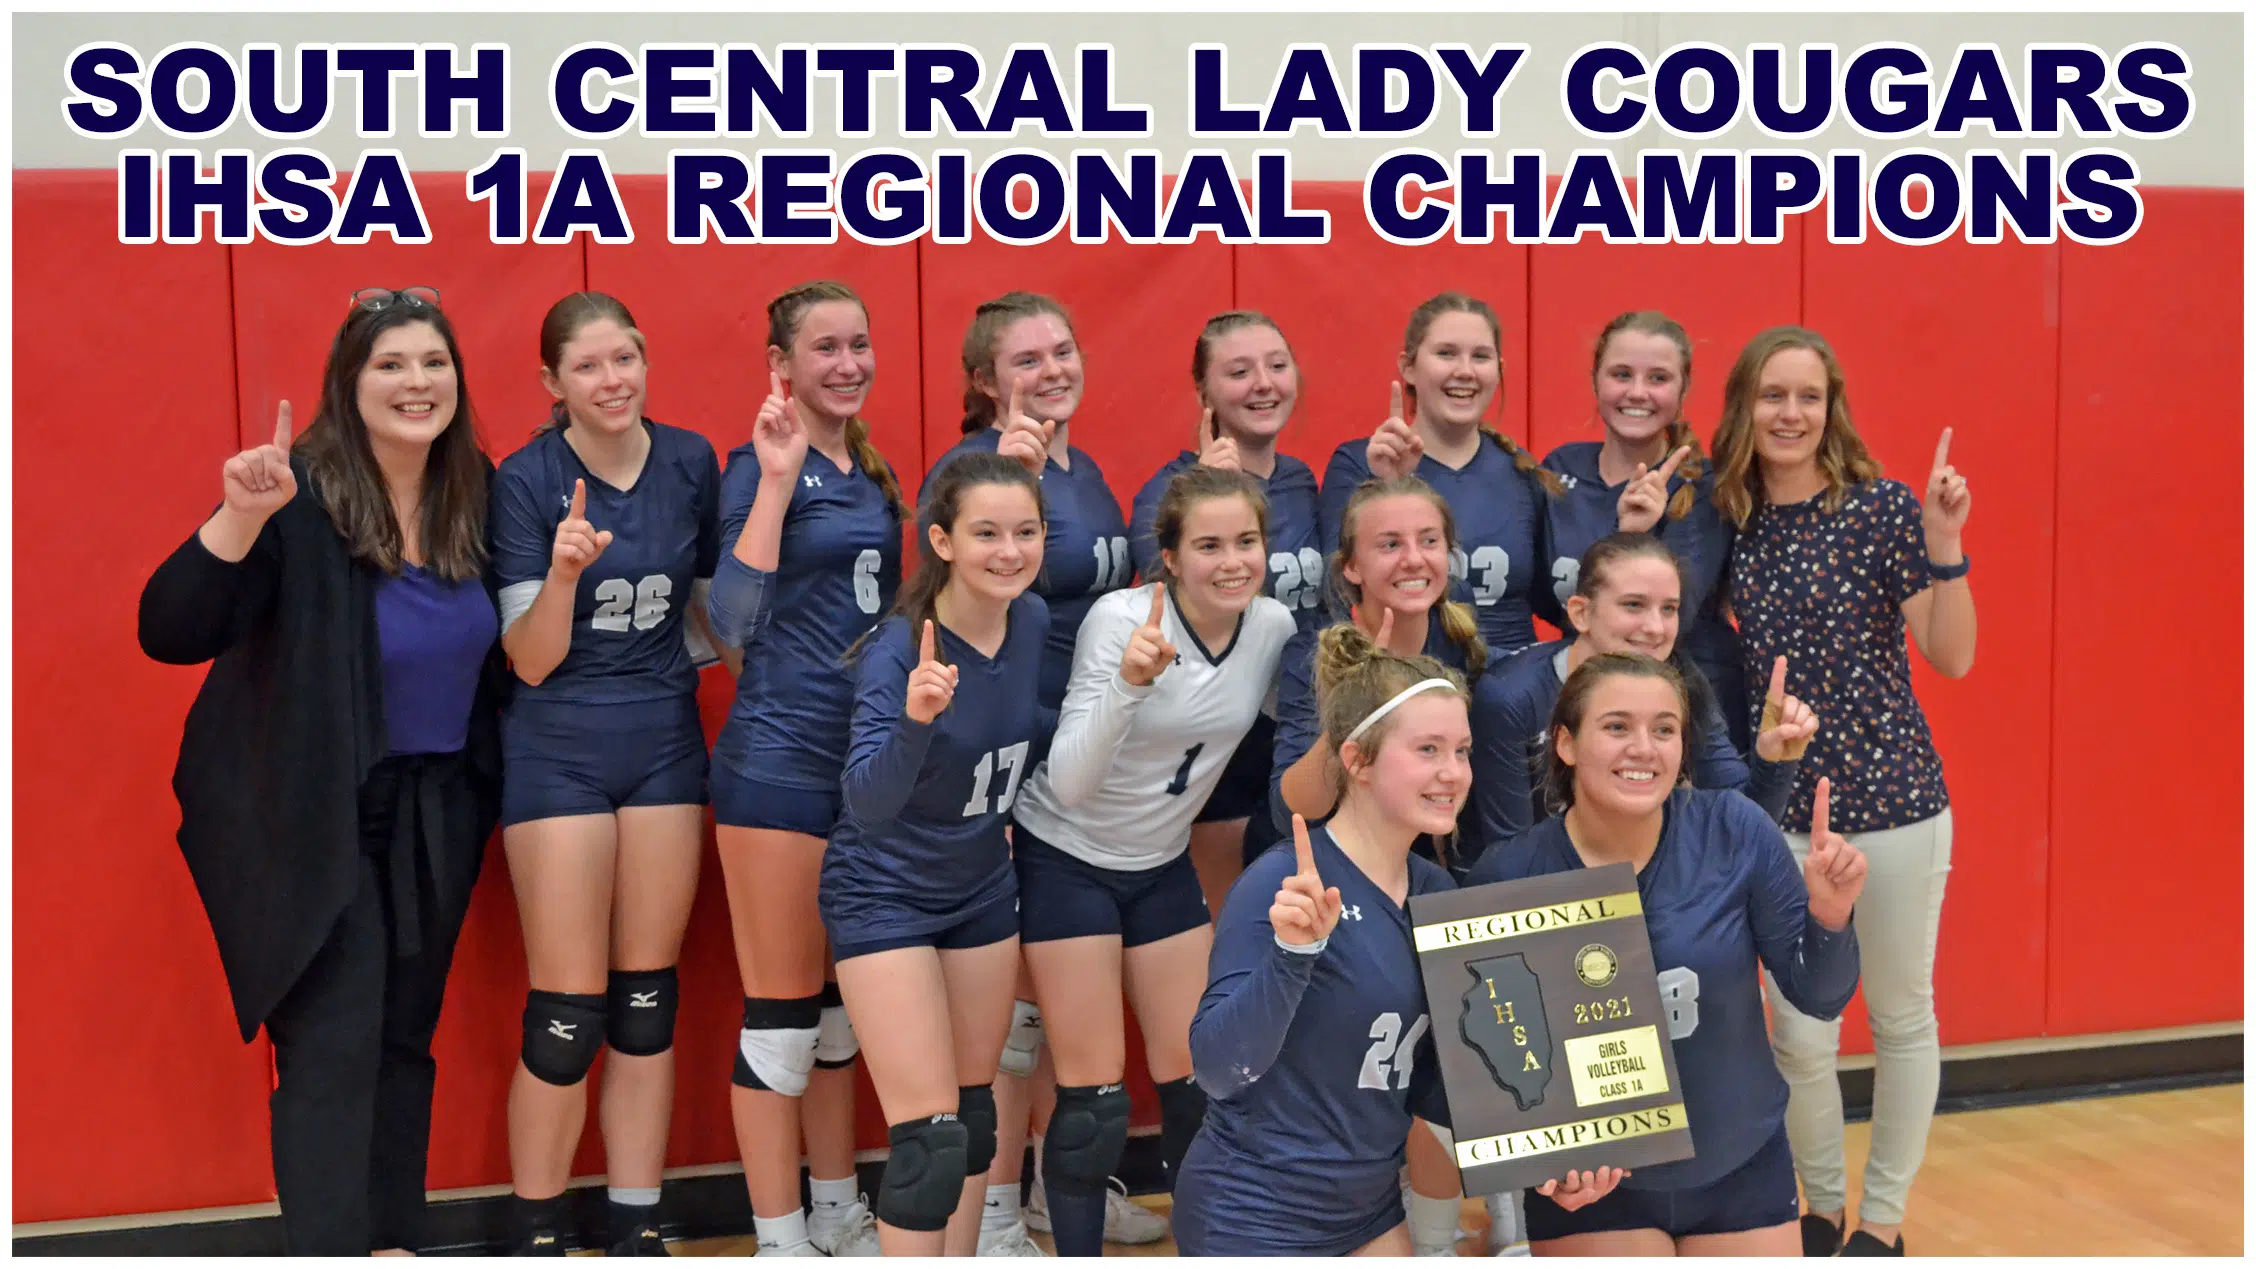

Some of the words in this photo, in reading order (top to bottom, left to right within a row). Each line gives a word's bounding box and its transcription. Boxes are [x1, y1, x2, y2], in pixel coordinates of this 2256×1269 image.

[592, 574, 672, 632] 26
[853, 549, 882, 614] 6
[1269, 547, 1323, 611] 29
[962, 741, 1029, 817] 17
[1166, 742, 1205, 796] 1
[1445, 900, 1616, 944] REGIONAL
[1574, 995, 1633, 1024] 2021
[1587, 1056, 1646, 1079] VOLLEYBALL
[1598, 1040, 1627, 1059] GIRLS
[1600, 1082, 1628, 1098] CLASS
[1631, 1079, 1644, 1092] 1A
[1470, 1108, 1672, 1161] CHAMPIONS
